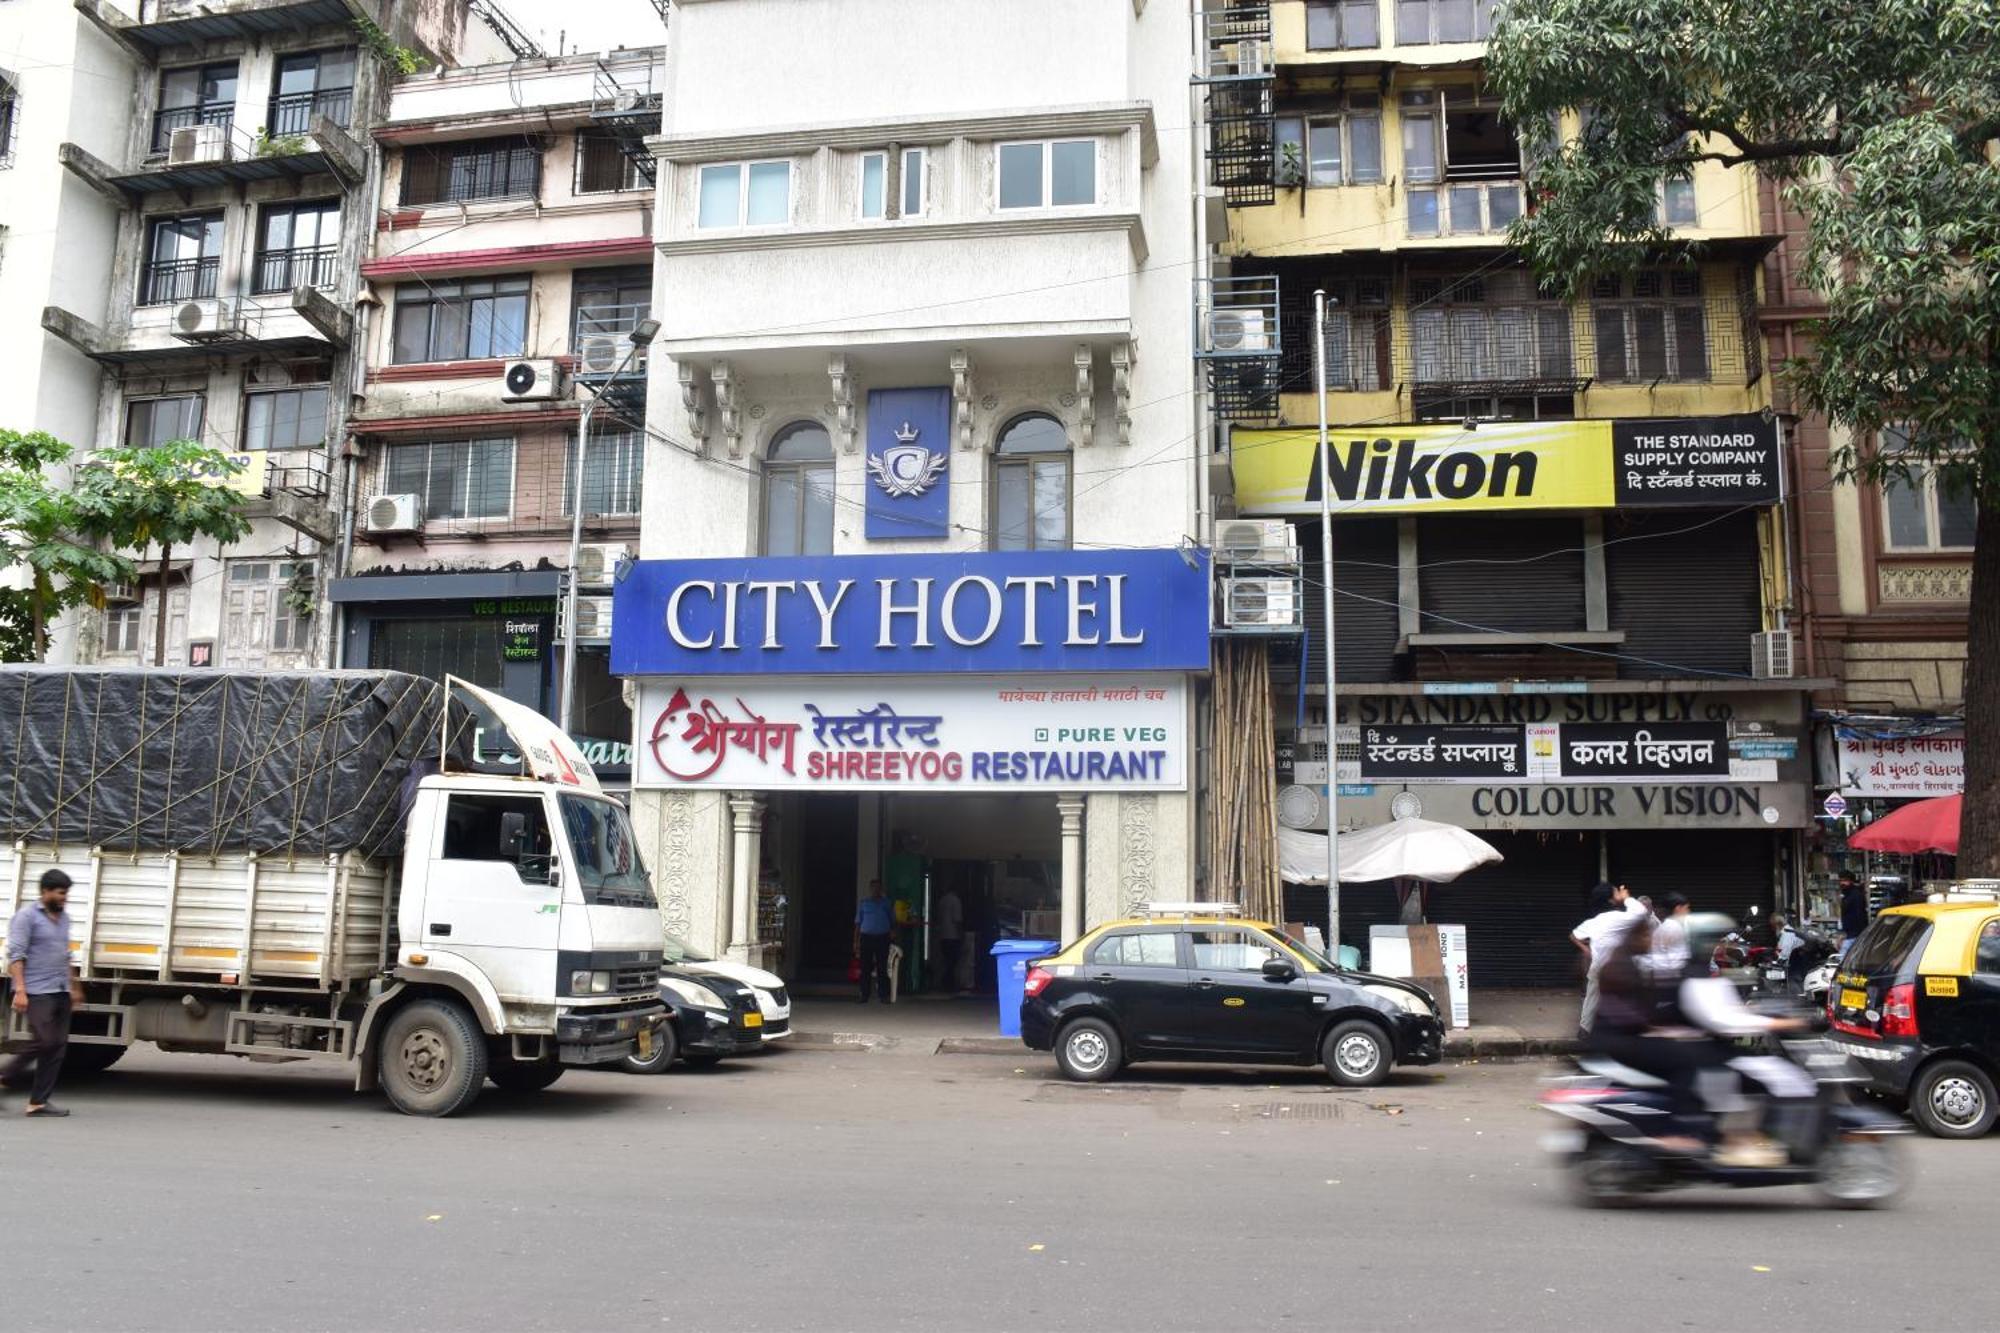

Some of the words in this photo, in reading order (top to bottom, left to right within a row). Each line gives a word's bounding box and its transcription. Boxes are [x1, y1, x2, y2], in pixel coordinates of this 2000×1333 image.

[1634, 435, 1665, 449] THE
[1669, 434, 1755, 449] STANDARD
[892, 452, 919, 481] C
[1305, 438, 1538, 502] Nikon
[1624, 452, 1684, 466] SUPPLY
[1688, 450, 1767, 465] COMPANY
[1627, 471, 1643, 490] दि
[666, 578, 855, 650] CITY
[875, 574, 1145, 648] HOTEL
[1359, 692, 1551, 724] STANDARD
[1566, 692, 1697, 723] SUPPLY
[1058, 727, 1116, 742] PURE
[1124, 727, 1167, 742] VEG
[1569, 740, 1629, 766] कलर
[1634, 729, 1715, 768] व्हिजन
[807, 750, 963, 781] SHREEYOG
[971, 749, 1167, 781] RESTAURANT
[1472, 786, 1617, 817] COLOUR
[1632, 785, 1761, 817] VISION
